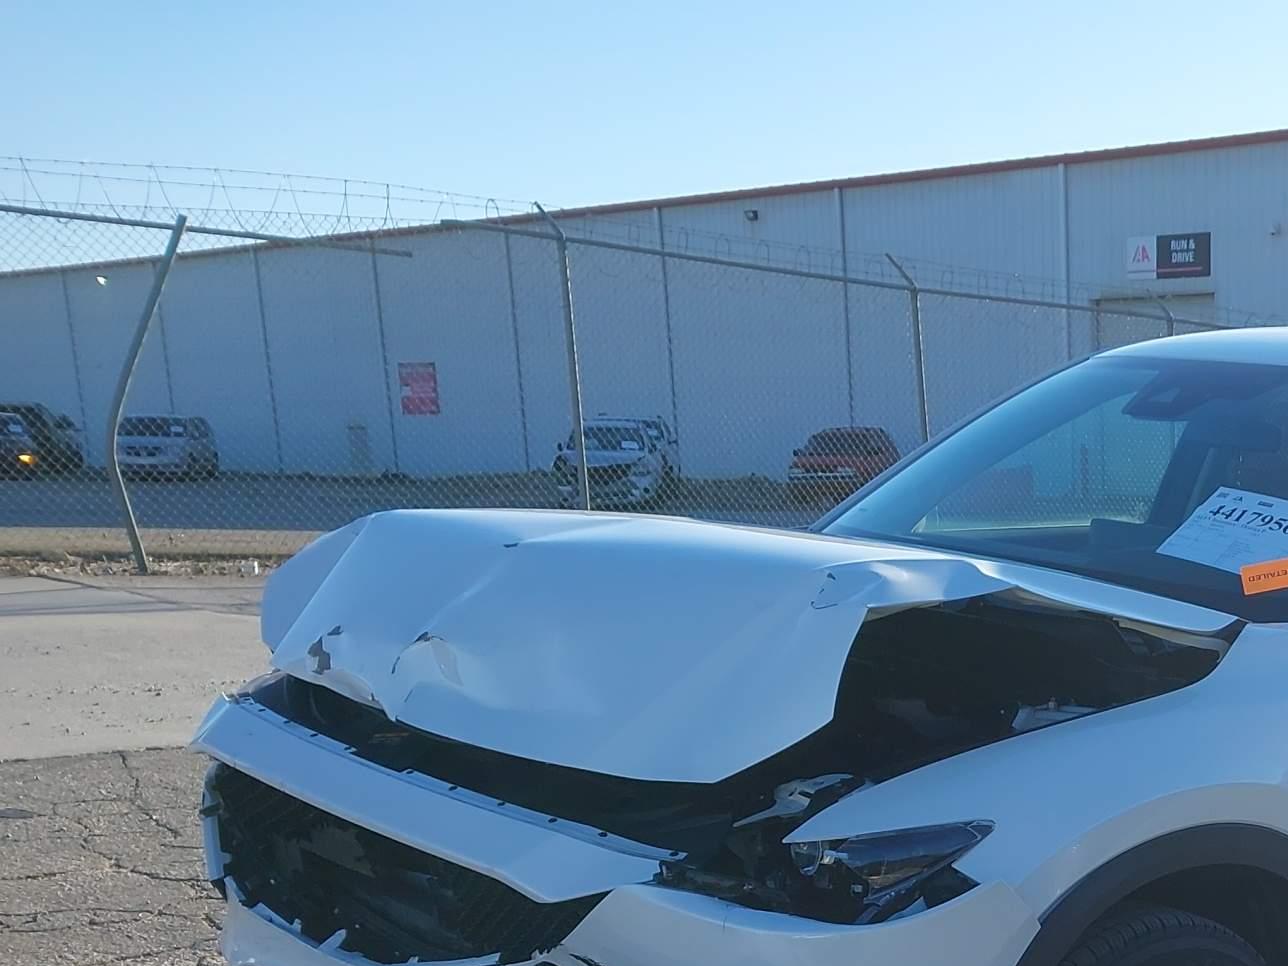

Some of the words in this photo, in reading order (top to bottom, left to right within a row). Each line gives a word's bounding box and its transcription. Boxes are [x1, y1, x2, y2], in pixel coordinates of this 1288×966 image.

[1170, 239, 1188, 251] RUN
[1188, 238, 1195, 249] &
[1172, 251, 1195, 263] DRIVE
